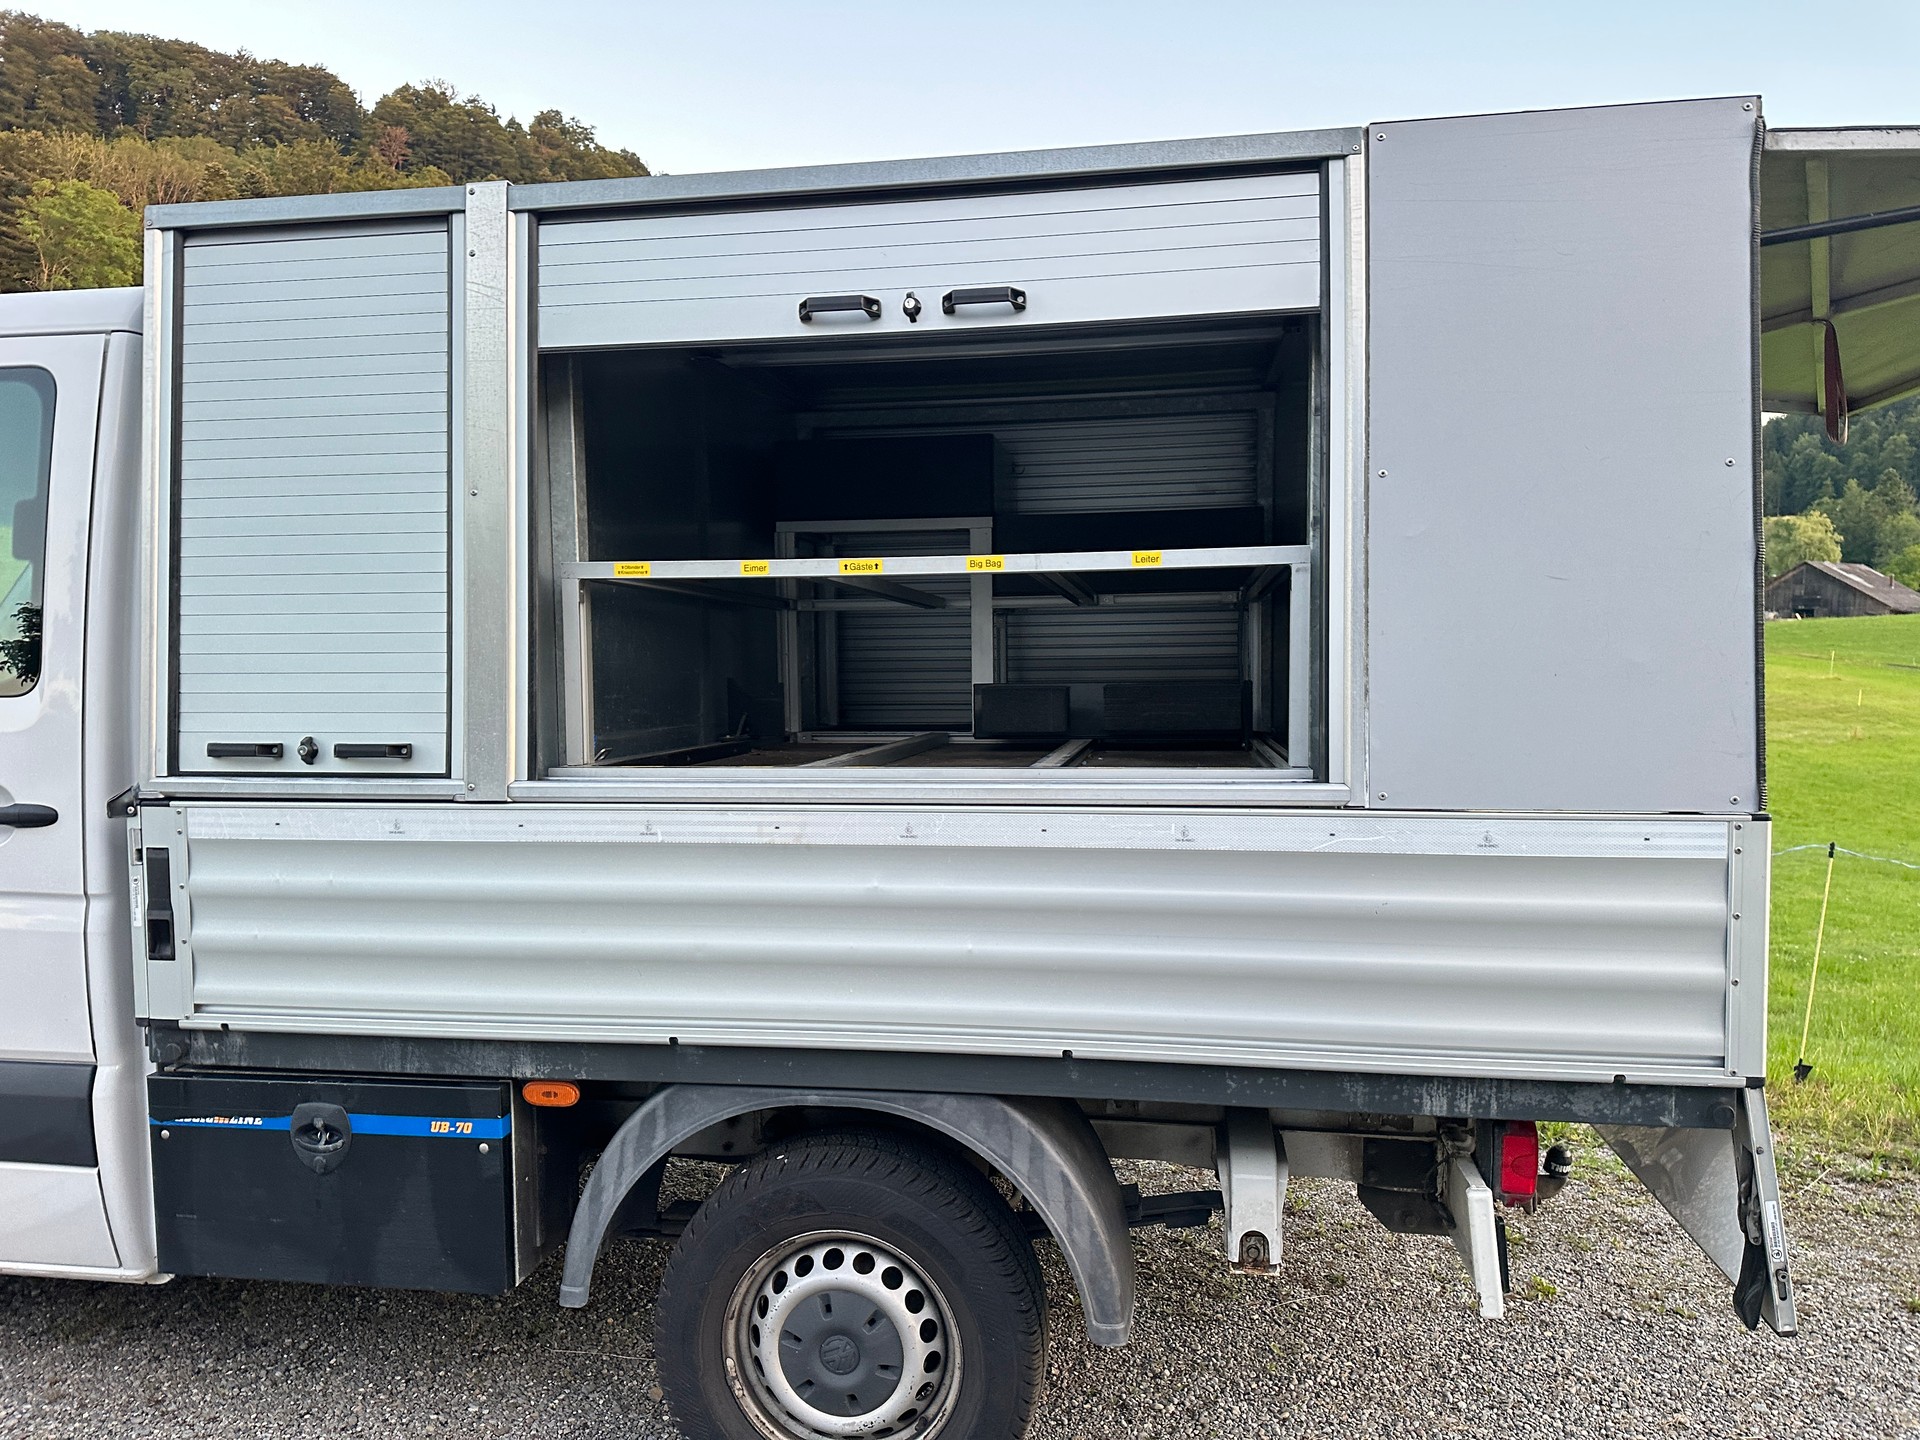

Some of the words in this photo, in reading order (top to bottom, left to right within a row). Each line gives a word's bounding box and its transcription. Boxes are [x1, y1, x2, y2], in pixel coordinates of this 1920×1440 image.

[969, 559, 983, 568] Big
[985, 559, 1002, 568] Bag
[1135, 555, 1160, 563] Leiter
[743, 564, 767, 572] Eimer
[849, 562, 874, 571] Gäste
[430, 1121, 473, 1134] UB-70
